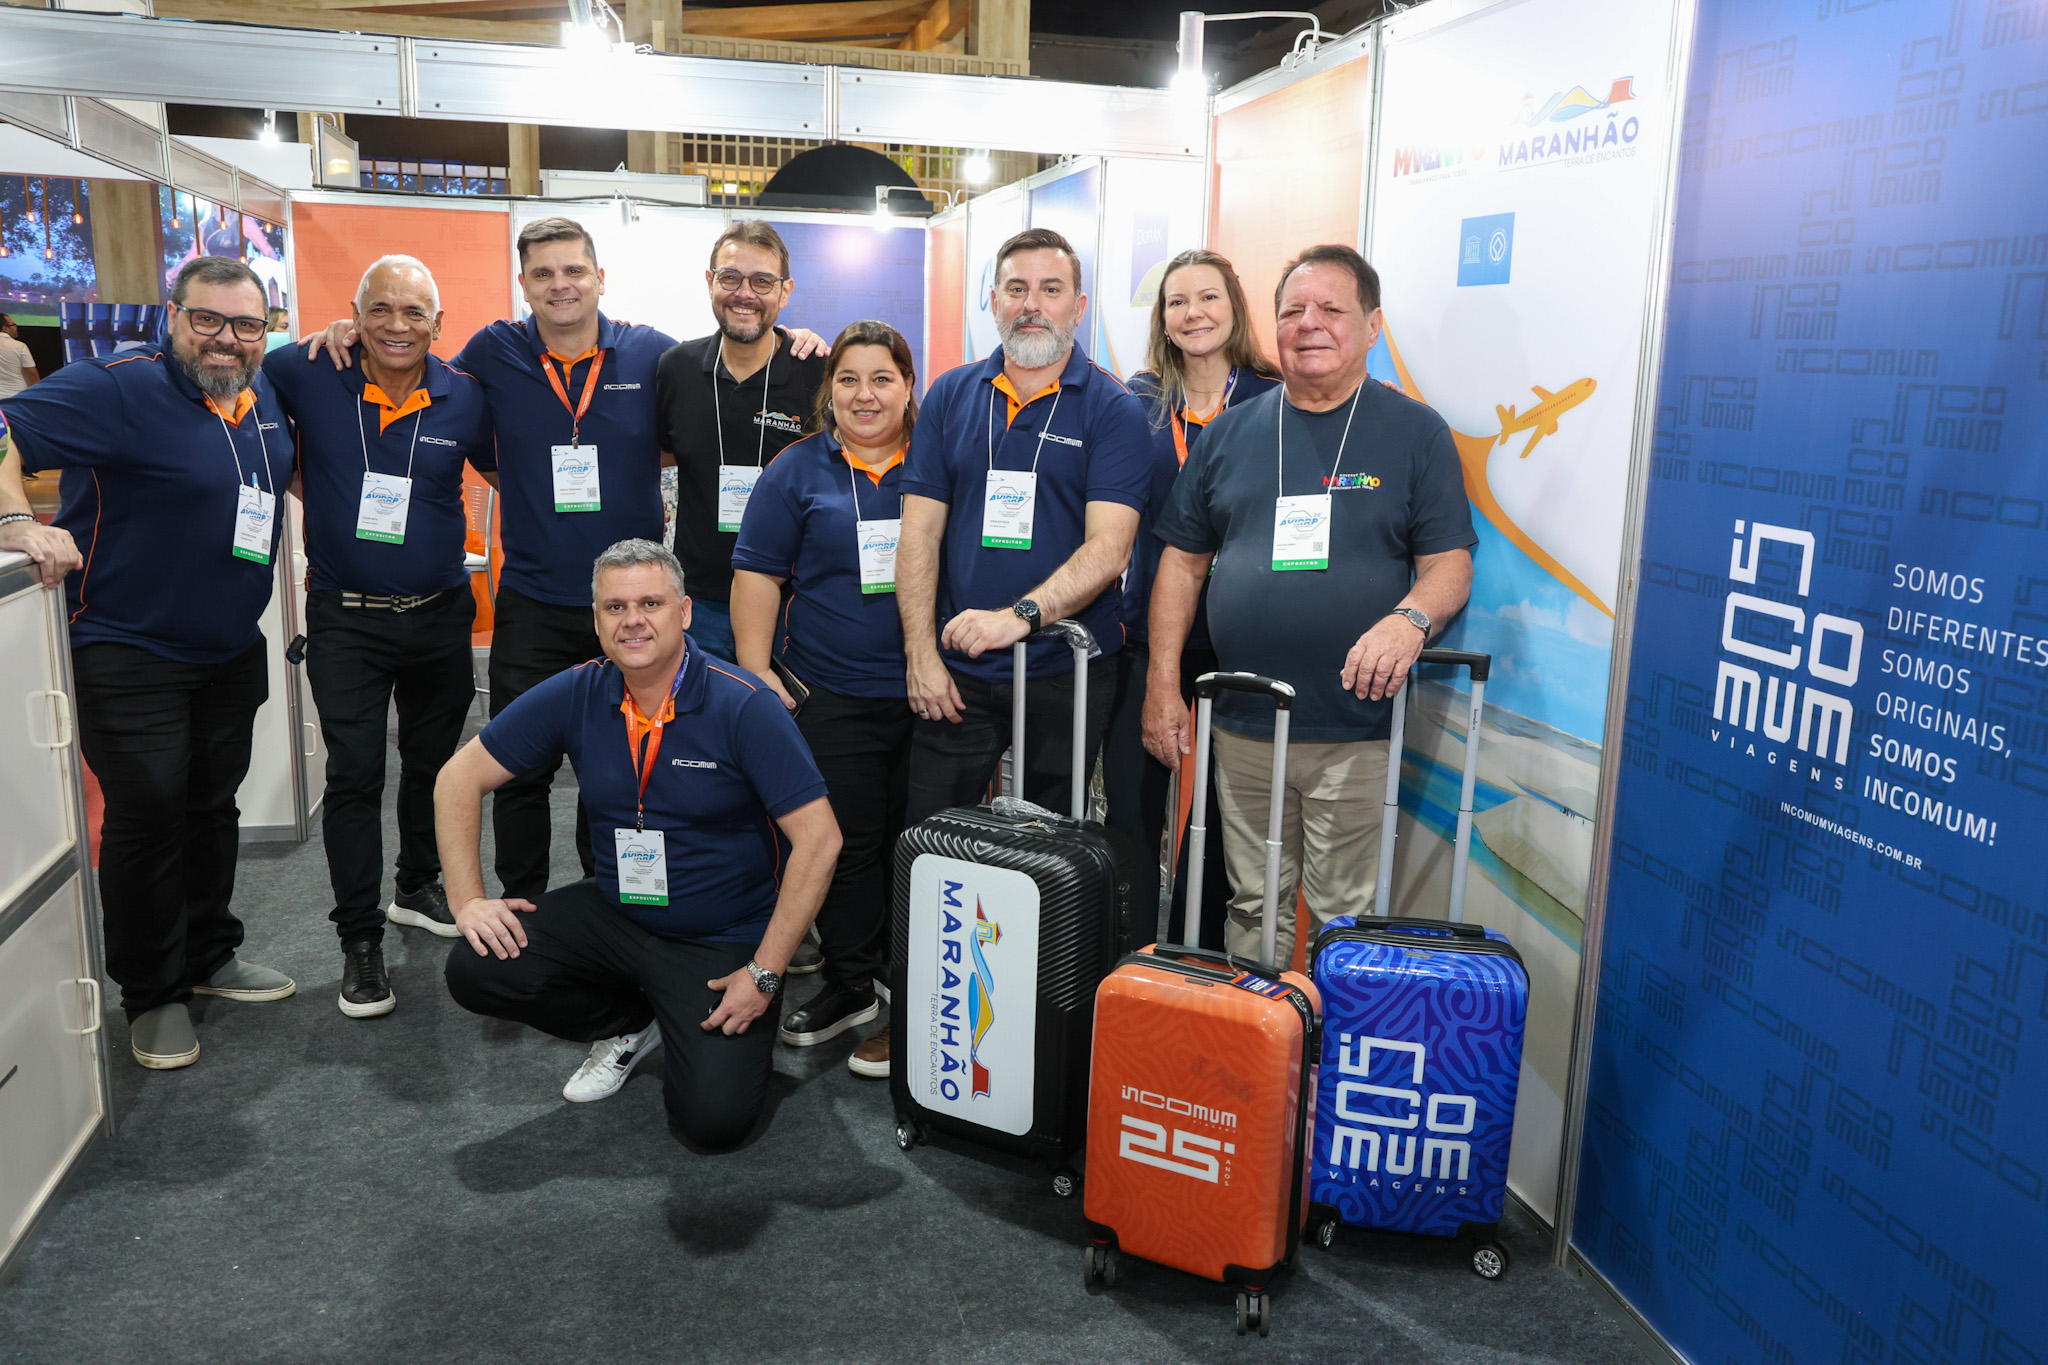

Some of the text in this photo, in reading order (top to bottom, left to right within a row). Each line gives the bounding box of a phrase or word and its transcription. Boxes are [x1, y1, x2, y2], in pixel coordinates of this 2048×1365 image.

[1498, 111, 1639, 167] MARANHÃO
[1564, 147, 1636, 168] TERRA DE ENCANTOS
[365, 531, 396, 540] EXPOSITOR
[1893, 563, 1985, 604] SOMOS
[1887, 606, 2048, 667] DIFERENTES
[1881, 649, 1971, 694] SOMOS
[1876, 691, 2011, 759] ORIGINAIS,
[1711, 729, 1844, 790] VIAGENS
[1869, 733, 1957, 783] SOMOS
[1780, 801, 1923, 871] INCOMUMVIAGENS.COM.BR
[1863, 775, 1997, 847] INCOMUM!
[940, 880, 967, 1101] MARANHÃO
[929, 992, 939, 1096] TERRA DE ENCANTOS
[1119, 1114, 1222, 1184] 25
[1192, 1119, 1236, 1134] VIAGENS
[1224, 1159, 1232, 1187] ANOS
[1328, 1170, 1468, 1196] VIAGENS
